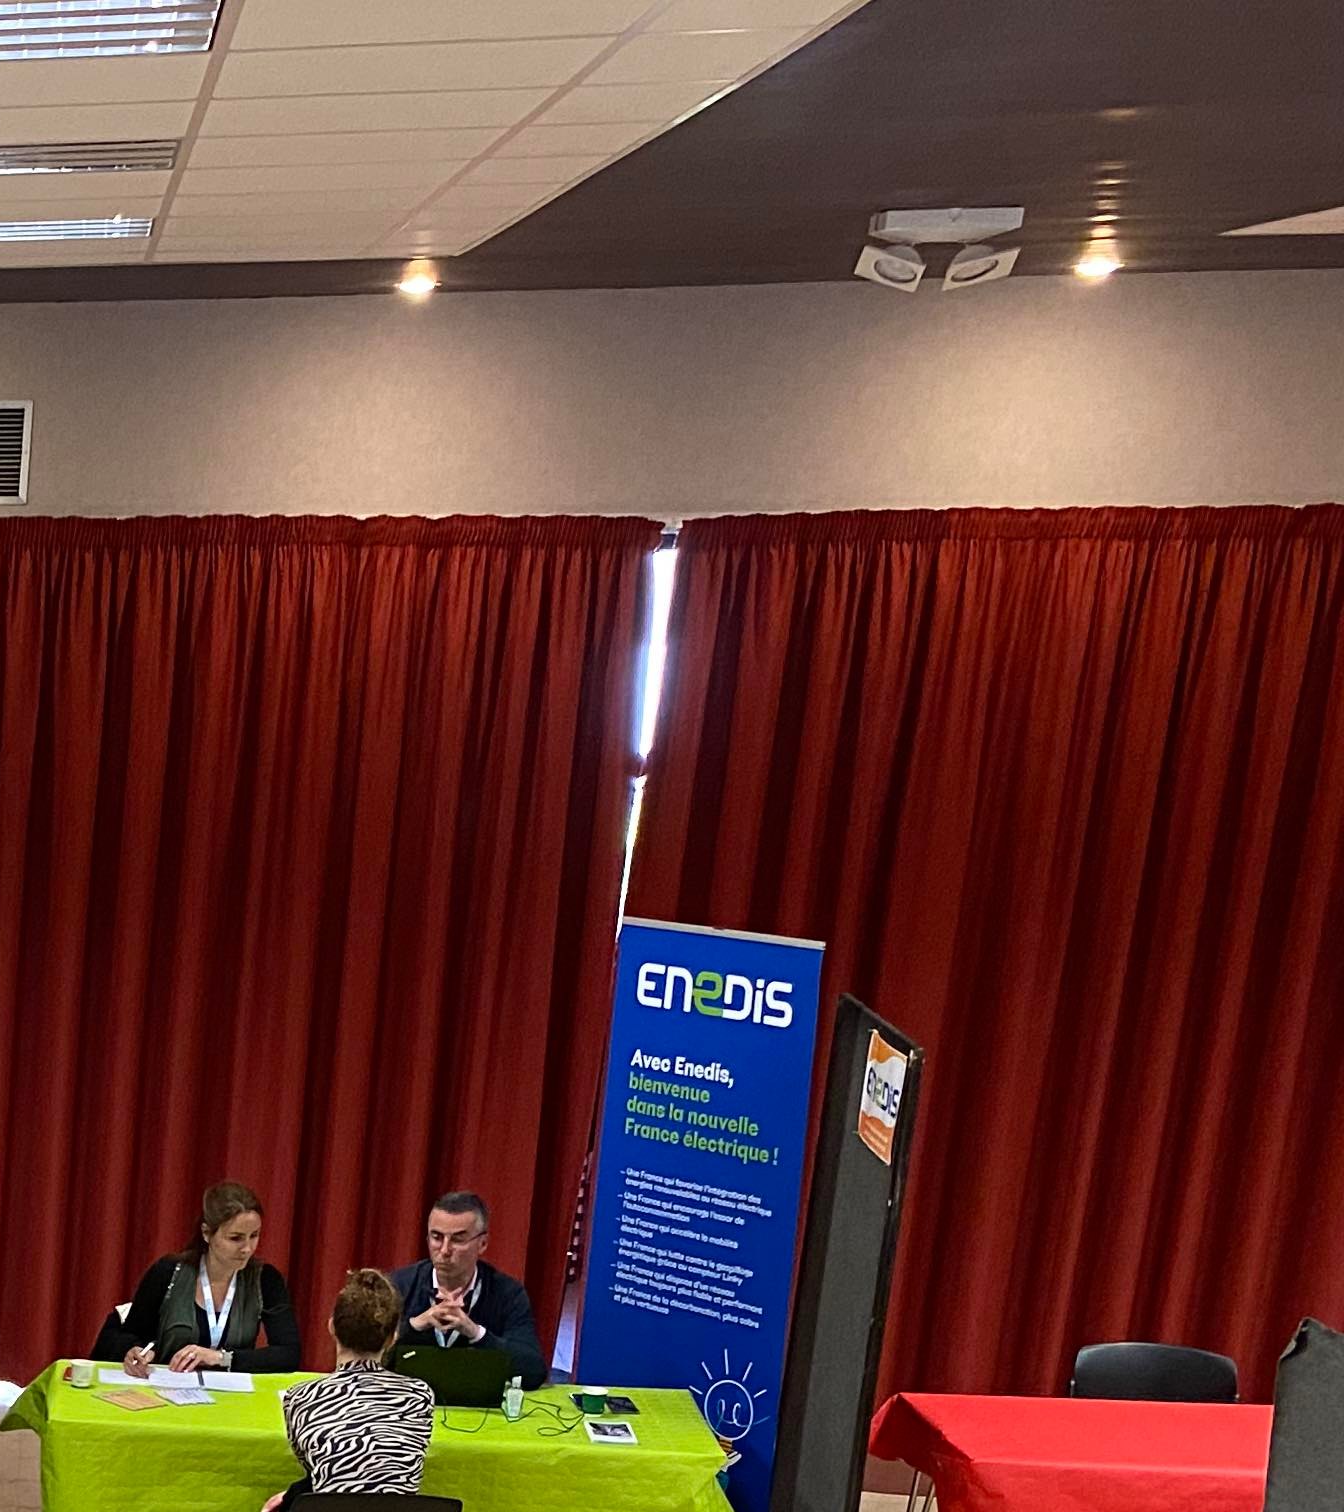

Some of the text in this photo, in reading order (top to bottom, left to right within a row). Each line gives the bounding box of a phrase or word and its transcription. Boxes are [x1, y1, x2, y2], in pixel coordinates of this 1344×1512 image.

[628, 1071, 710, 1103] bienvenue
[630, 1049, 734, 1089] Avec Enedis,
[626, 1095, 759, 1136] dans la nouvelle
[625, 1117, 679, 1144] France
[683, 1129, 769, 1165] électrique
